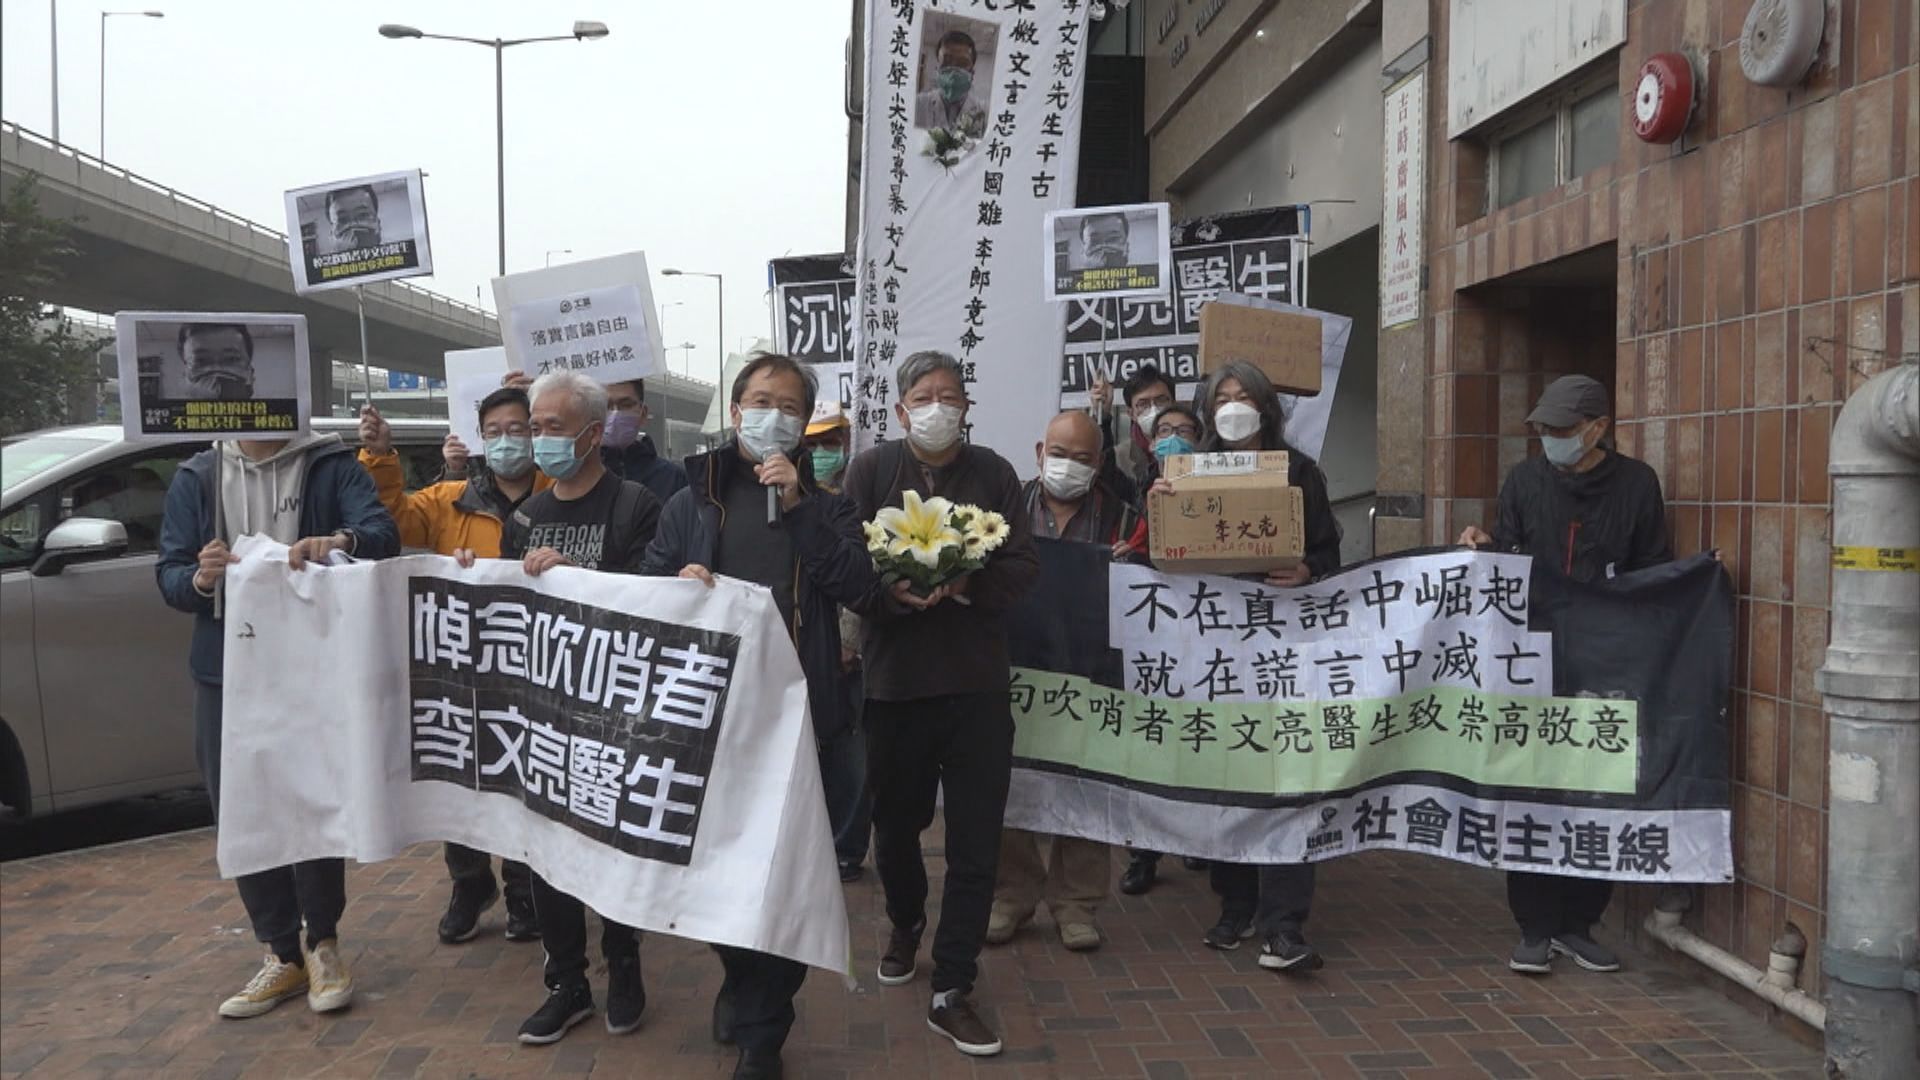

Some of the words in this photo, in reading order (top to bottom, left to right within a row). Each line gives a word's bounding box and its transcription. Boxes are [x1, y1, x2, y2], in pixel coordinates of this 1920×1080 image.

[530, 316, 629, 346] 落實言論自由
[536, 345, 635, 376] 才是最好悼念
[1087, 347, 1200, 383] Wenlia
[1181, 496, 1223, 518] 送別
[1165, 546, 1187, 560] RIP
[1124, 565, 1528, 641] 不在真話中崛起
[413, 590, 729, 730] 悼念吹哨者
[1132, 629, 1541, 702] 就在謊言中滅亡
[1008, 670, 1631, 755] 向吹哨者李文亮醫生致崇高敬意
[413, 696, 705, 848] 李文亮醫生
[1351, 795, 1672, 875] 社會民主連線
